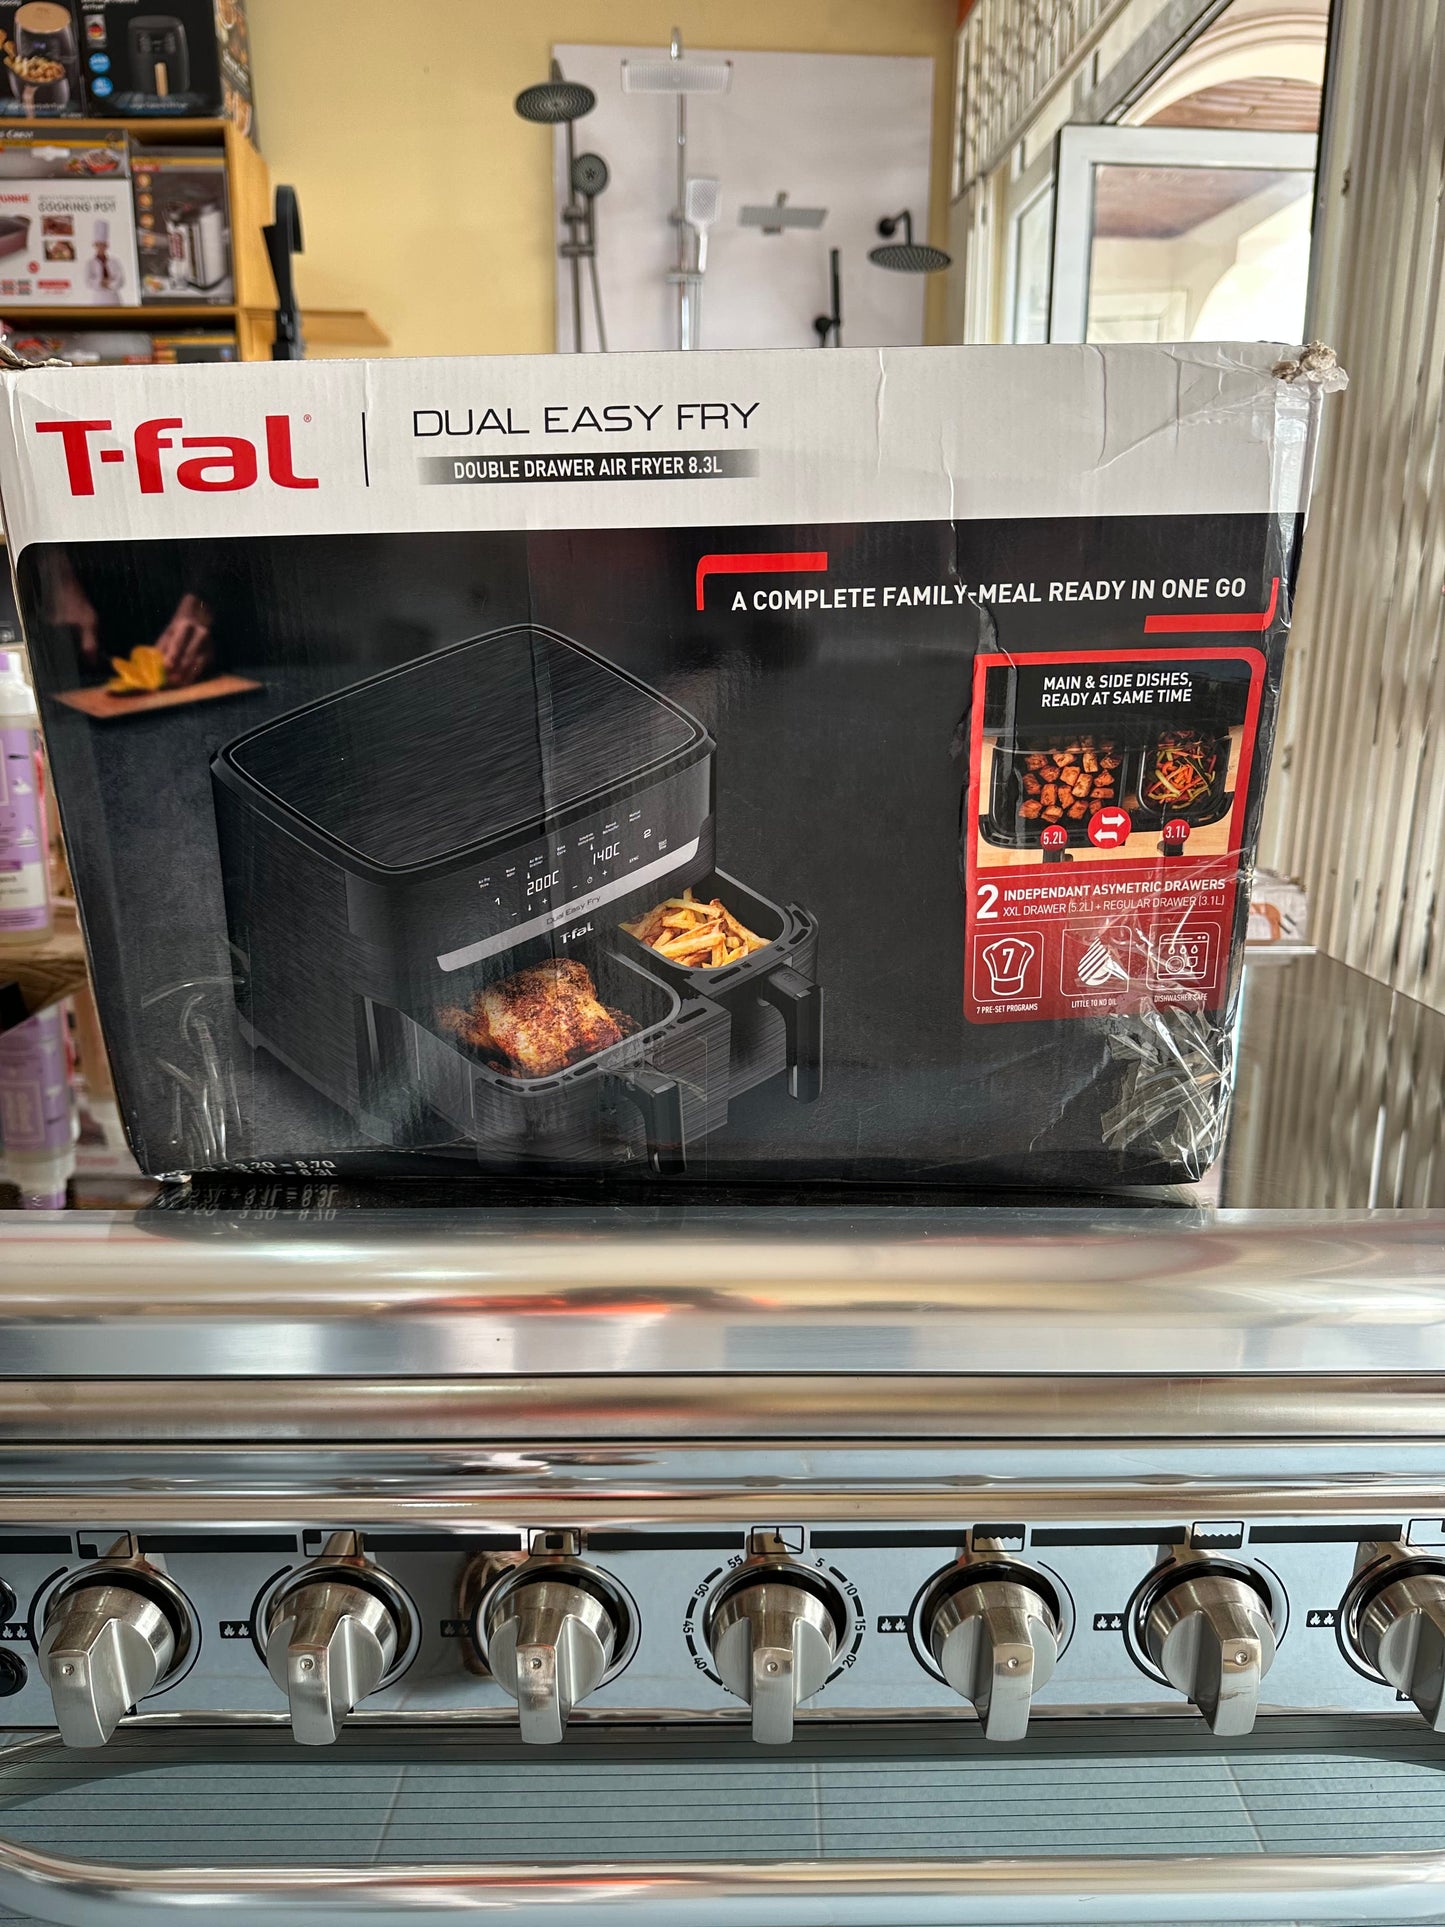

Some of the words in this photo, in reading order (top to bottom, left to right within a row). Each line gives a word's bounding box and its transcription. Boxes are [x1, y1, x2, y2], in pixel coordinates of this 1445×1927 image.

[413, 408, 530, 437] DUAL
[544, 404, 664, 433] EASY
[677, 402, 760, 430] FRY
[35, 415, 319, 496] T-fal
[454, 460, 520, 480] DOUBLE
[524, 458, 595, 478] DRAWER
[599, 457, 627, 477] AIR
[631, 456, 684, 476] FRYER
[688, 455, 723, 474] 8.3L
[731, 591, 747, 611] A
[753, 587, 876, 610] COMPLETE
[1049, 580, 1126, 602] READY
[1131, 579, 1154, 600] IN
[1161, 578, 1210, 599] ONE
[1215, 577, 1246, 598] GO
[1043, 675, 1081, 691] MAIN
[1085, 675, 1096, 689] &
[1099, 673, 1133, 688] SIDE
[1136, 672, 1193, 688] DISHES,
[1041, 692, 1090, 708] READY
[1091, 691, 1110, 706] AT
[1112, 690, 1153, 705] SAME
[1157, 688, 1193, 703] TIME
[1043, 831, 1064, 846] 5.2L
[1165, 825, 1187, 839] 3.1L
[1003, 885, 1091, 901] INDEPENDANT
[1092, 881, 1162, 896] ASYMETRIC
[1164, 878, 1227, 893] DRAWERS
[976, 883, 999, 920] 2
[1003, 905, 1022, 917] XXL
[1023, 903, 1067, 916] DRAWER
[1068, 900, 1095, 914] (5.2L)
[1103, 897, 1151, 910] REGULAR
[1153, 895, 1197, 909] DRAWER
[1198, 893, 1226, 907] (3.1L)
[560, 921, 595, 944] T-fal
[1002, 948, 1015, 975] 7
[976, 1006, 981, 1015] 7
[981, 1004, 1005, 1014] PRE-SET
[1006, 1003, 1039, 1013] PROGRAMS
[1071, 1000, 1089, 1009] LITTLE
[727, 1554, 743, 1569] 55
[815, 1557, 825, 1567] 5
[694, 1583, 709, 1598] 50
[844, 1582, 858, 1596] 10
[683, 1622, 694, 1633] 45
[855, 1618, 866, 1631] 15
[694, 1657, 707, 1669] 40
[842, 1654, 857, 1668] 20
